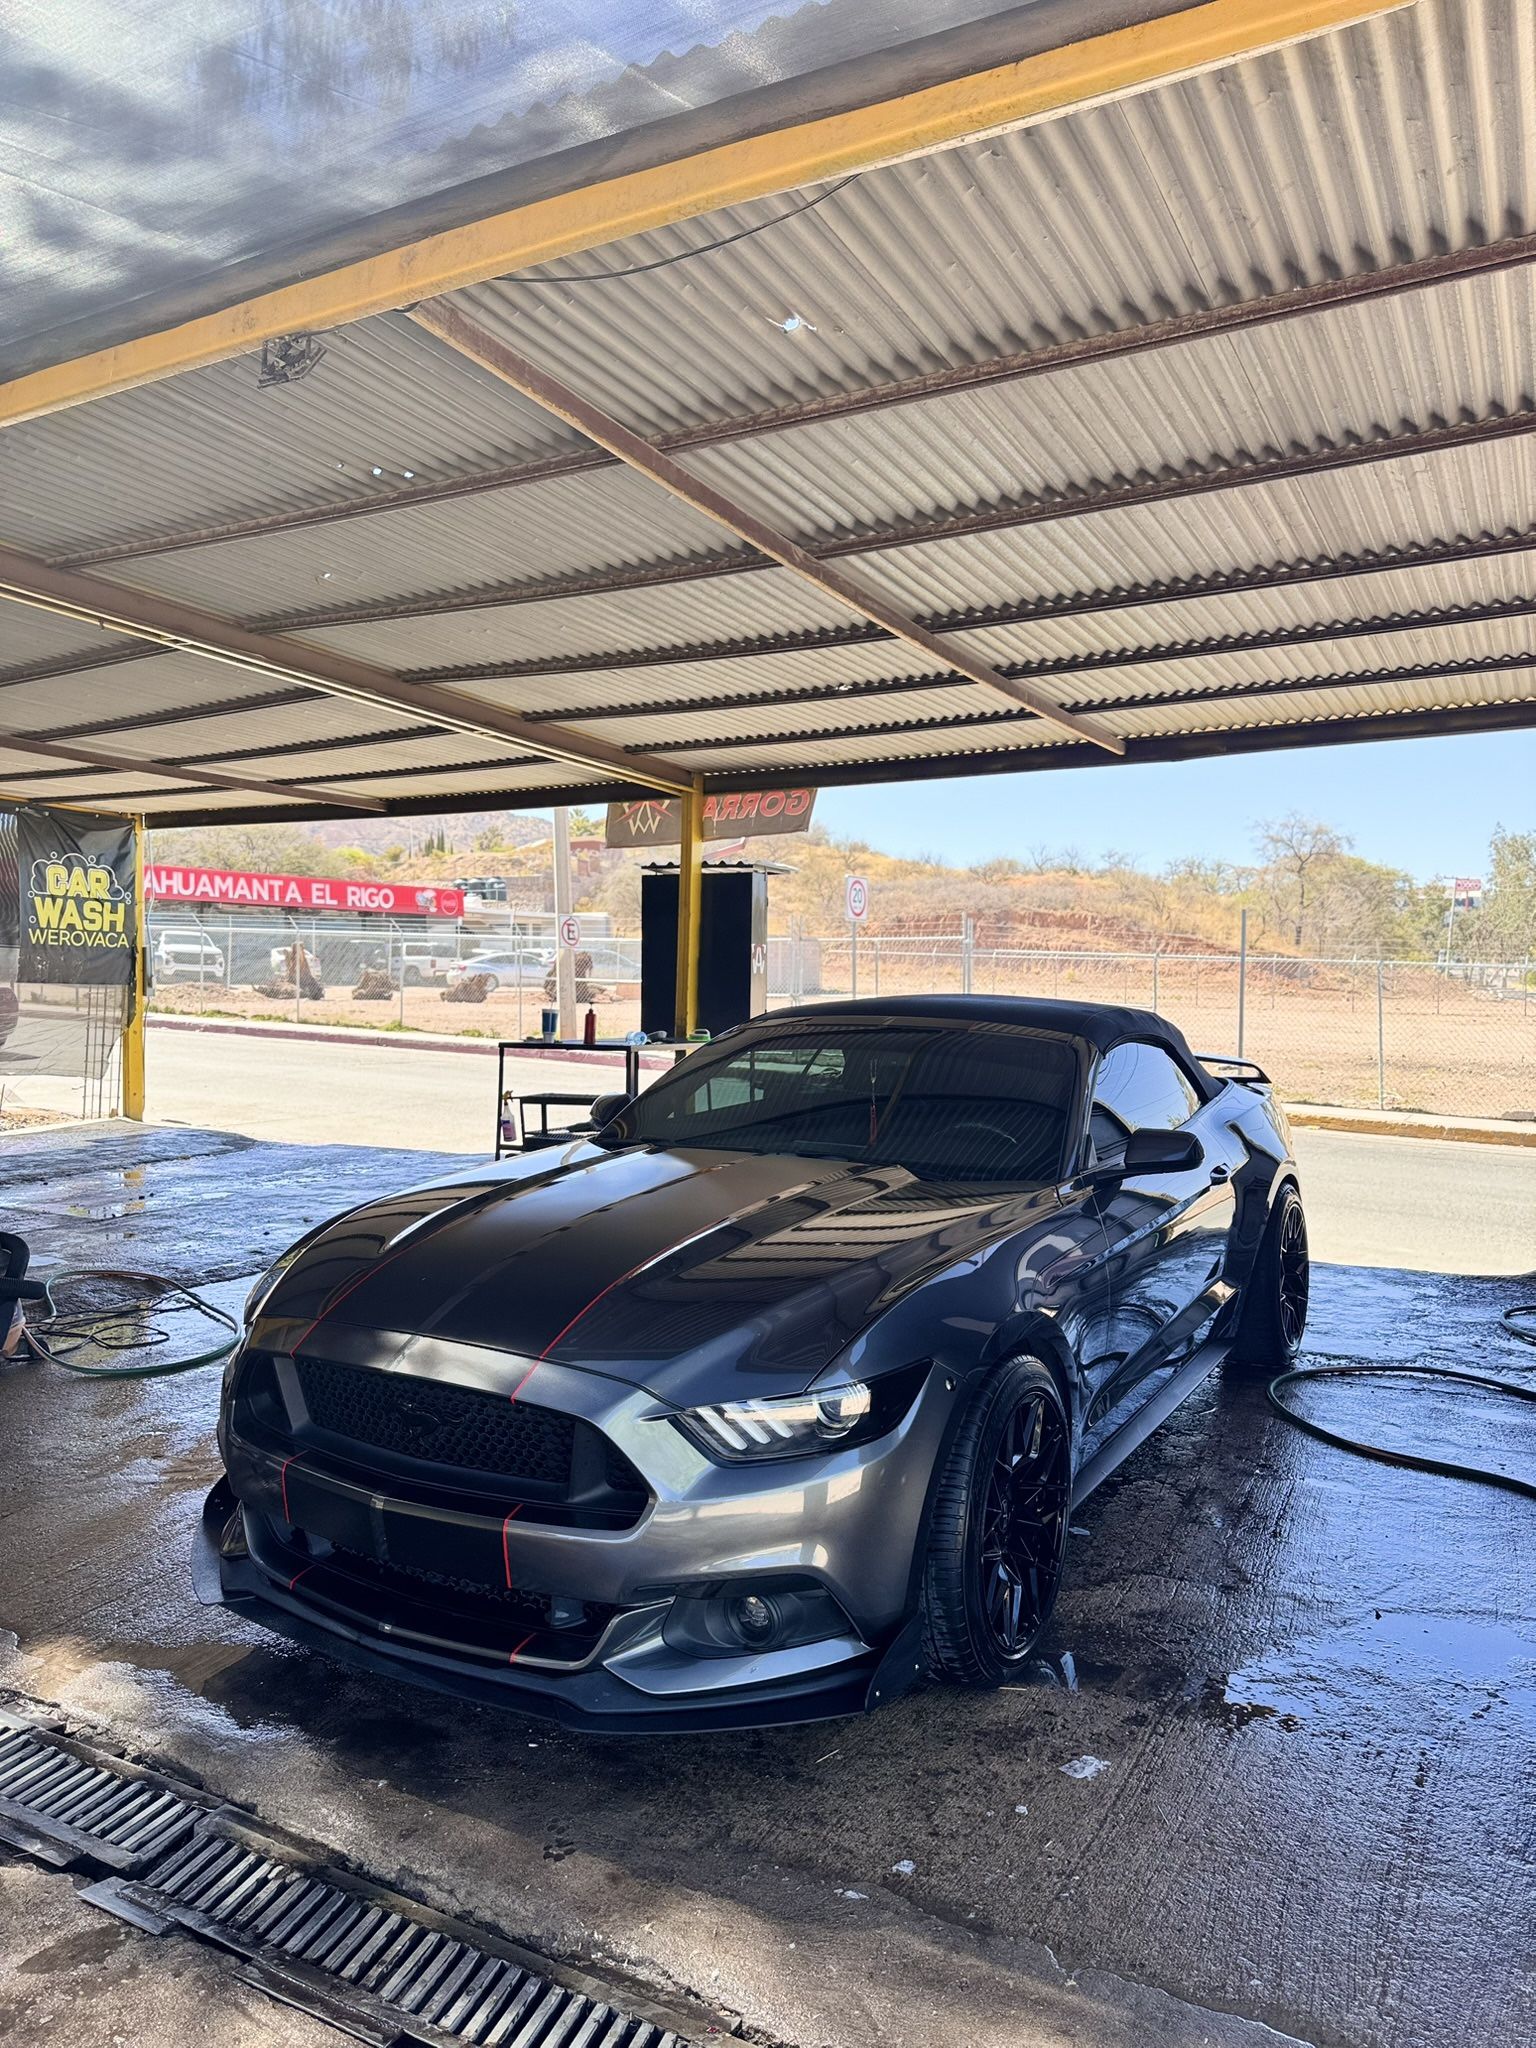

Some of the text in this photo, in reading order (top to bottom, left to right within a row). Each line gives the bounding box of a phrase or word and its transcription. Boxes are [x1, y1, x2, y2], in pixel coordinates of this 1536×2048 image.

[46, 864, 112, 899] CAR
[144, 869, 395, 909] AHUAMANTA EL RIGO
[853, 887, 863, 904] 20
[34, 896, 125, 932] WASH
[28, 928, 130, 948] WEROVACA
[566, 923, 576, 940] E
